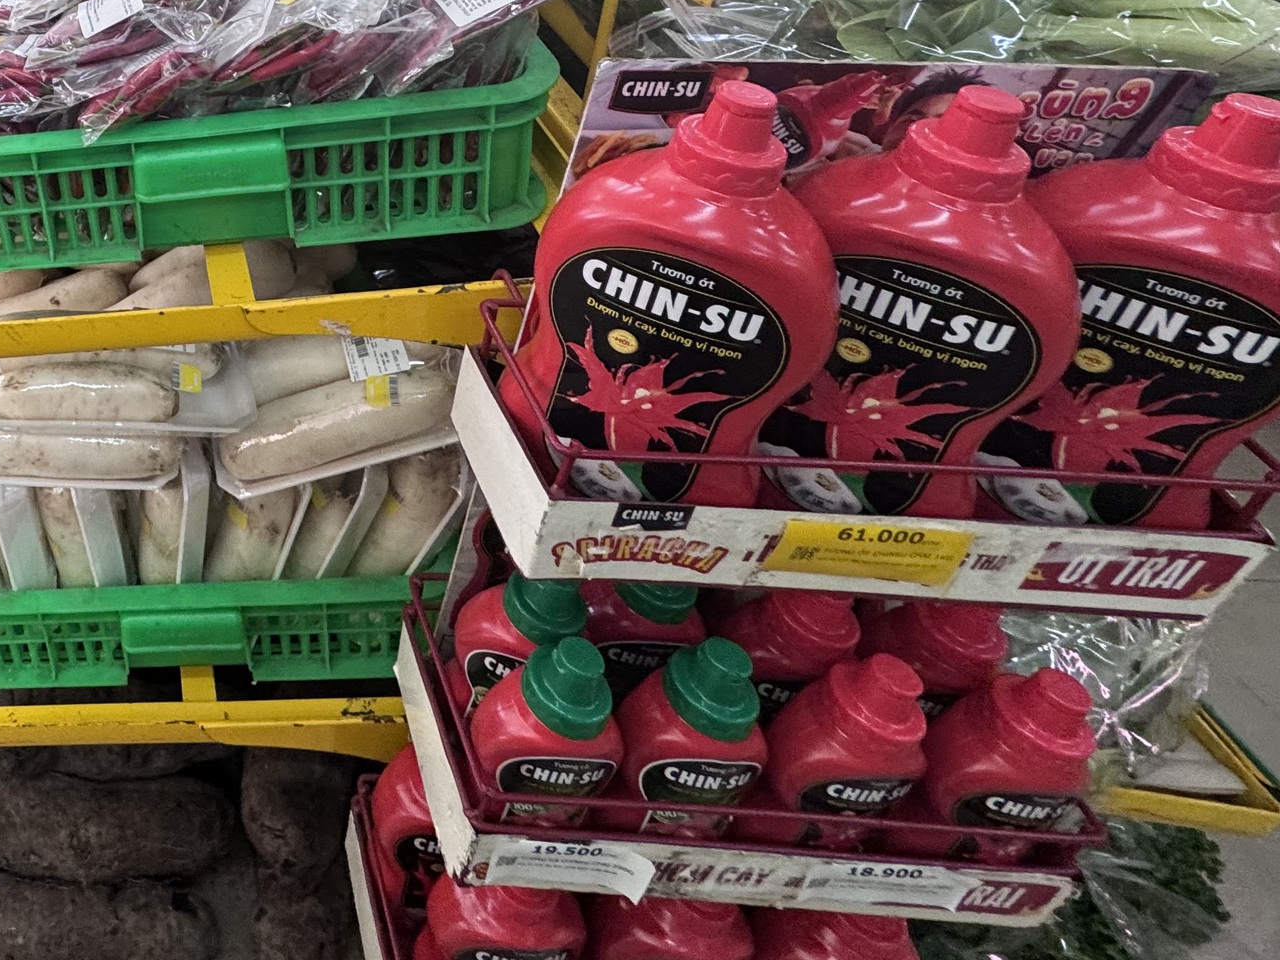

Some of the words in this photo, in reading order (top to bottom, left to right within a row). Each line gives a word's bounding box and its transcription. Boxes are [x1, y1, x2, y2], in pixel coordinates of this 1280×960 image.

[621, 81, 702, 97] CHIN-SU
[772, 110, 804, 155] HIN-SU
[651, 259, 695, 286] Tương
[698, 274, 716, 291] ớt
[892, 268, 941, 295] Tương
[944, 285, 965, 301] ớt
[582, 257, 765, 343] CHIN-SU
[1146, 278, 1201, 305] Tương
[1204, 296, 1229, 311] ớt
[586, 296, 620, 320] Đượm
[622, 313, 634, 327] vị
[660, 326, 693, 349] bùng
[695, 341, 709, 353] vị
[710, 345, 743, 361] ngon
[837, 271, 1016, 354] HIN-SU
[853, 322, 868, 337] vị
[897, 336, 933, 359] bùng
[936, 350, 951, 365] vị
[952, 356, 989, 372] ngon
[1096, 330, 1111, 344] vị
[1144, 346, 1186, 369] bùng
[1188, 361, 1204, 375] vị
[1204, 366, 1246, 383] ngon
[621, 508, 684, 523] CHIN-SU
[837, 527, 926, 545] 61.000
[519, 763, 606, 785] CHIN-SU
[663, 765, 752, 790] CHIN-SU
[531, 844, 603, 857] 19.500
[847, 866, 923, 879] 18.900
